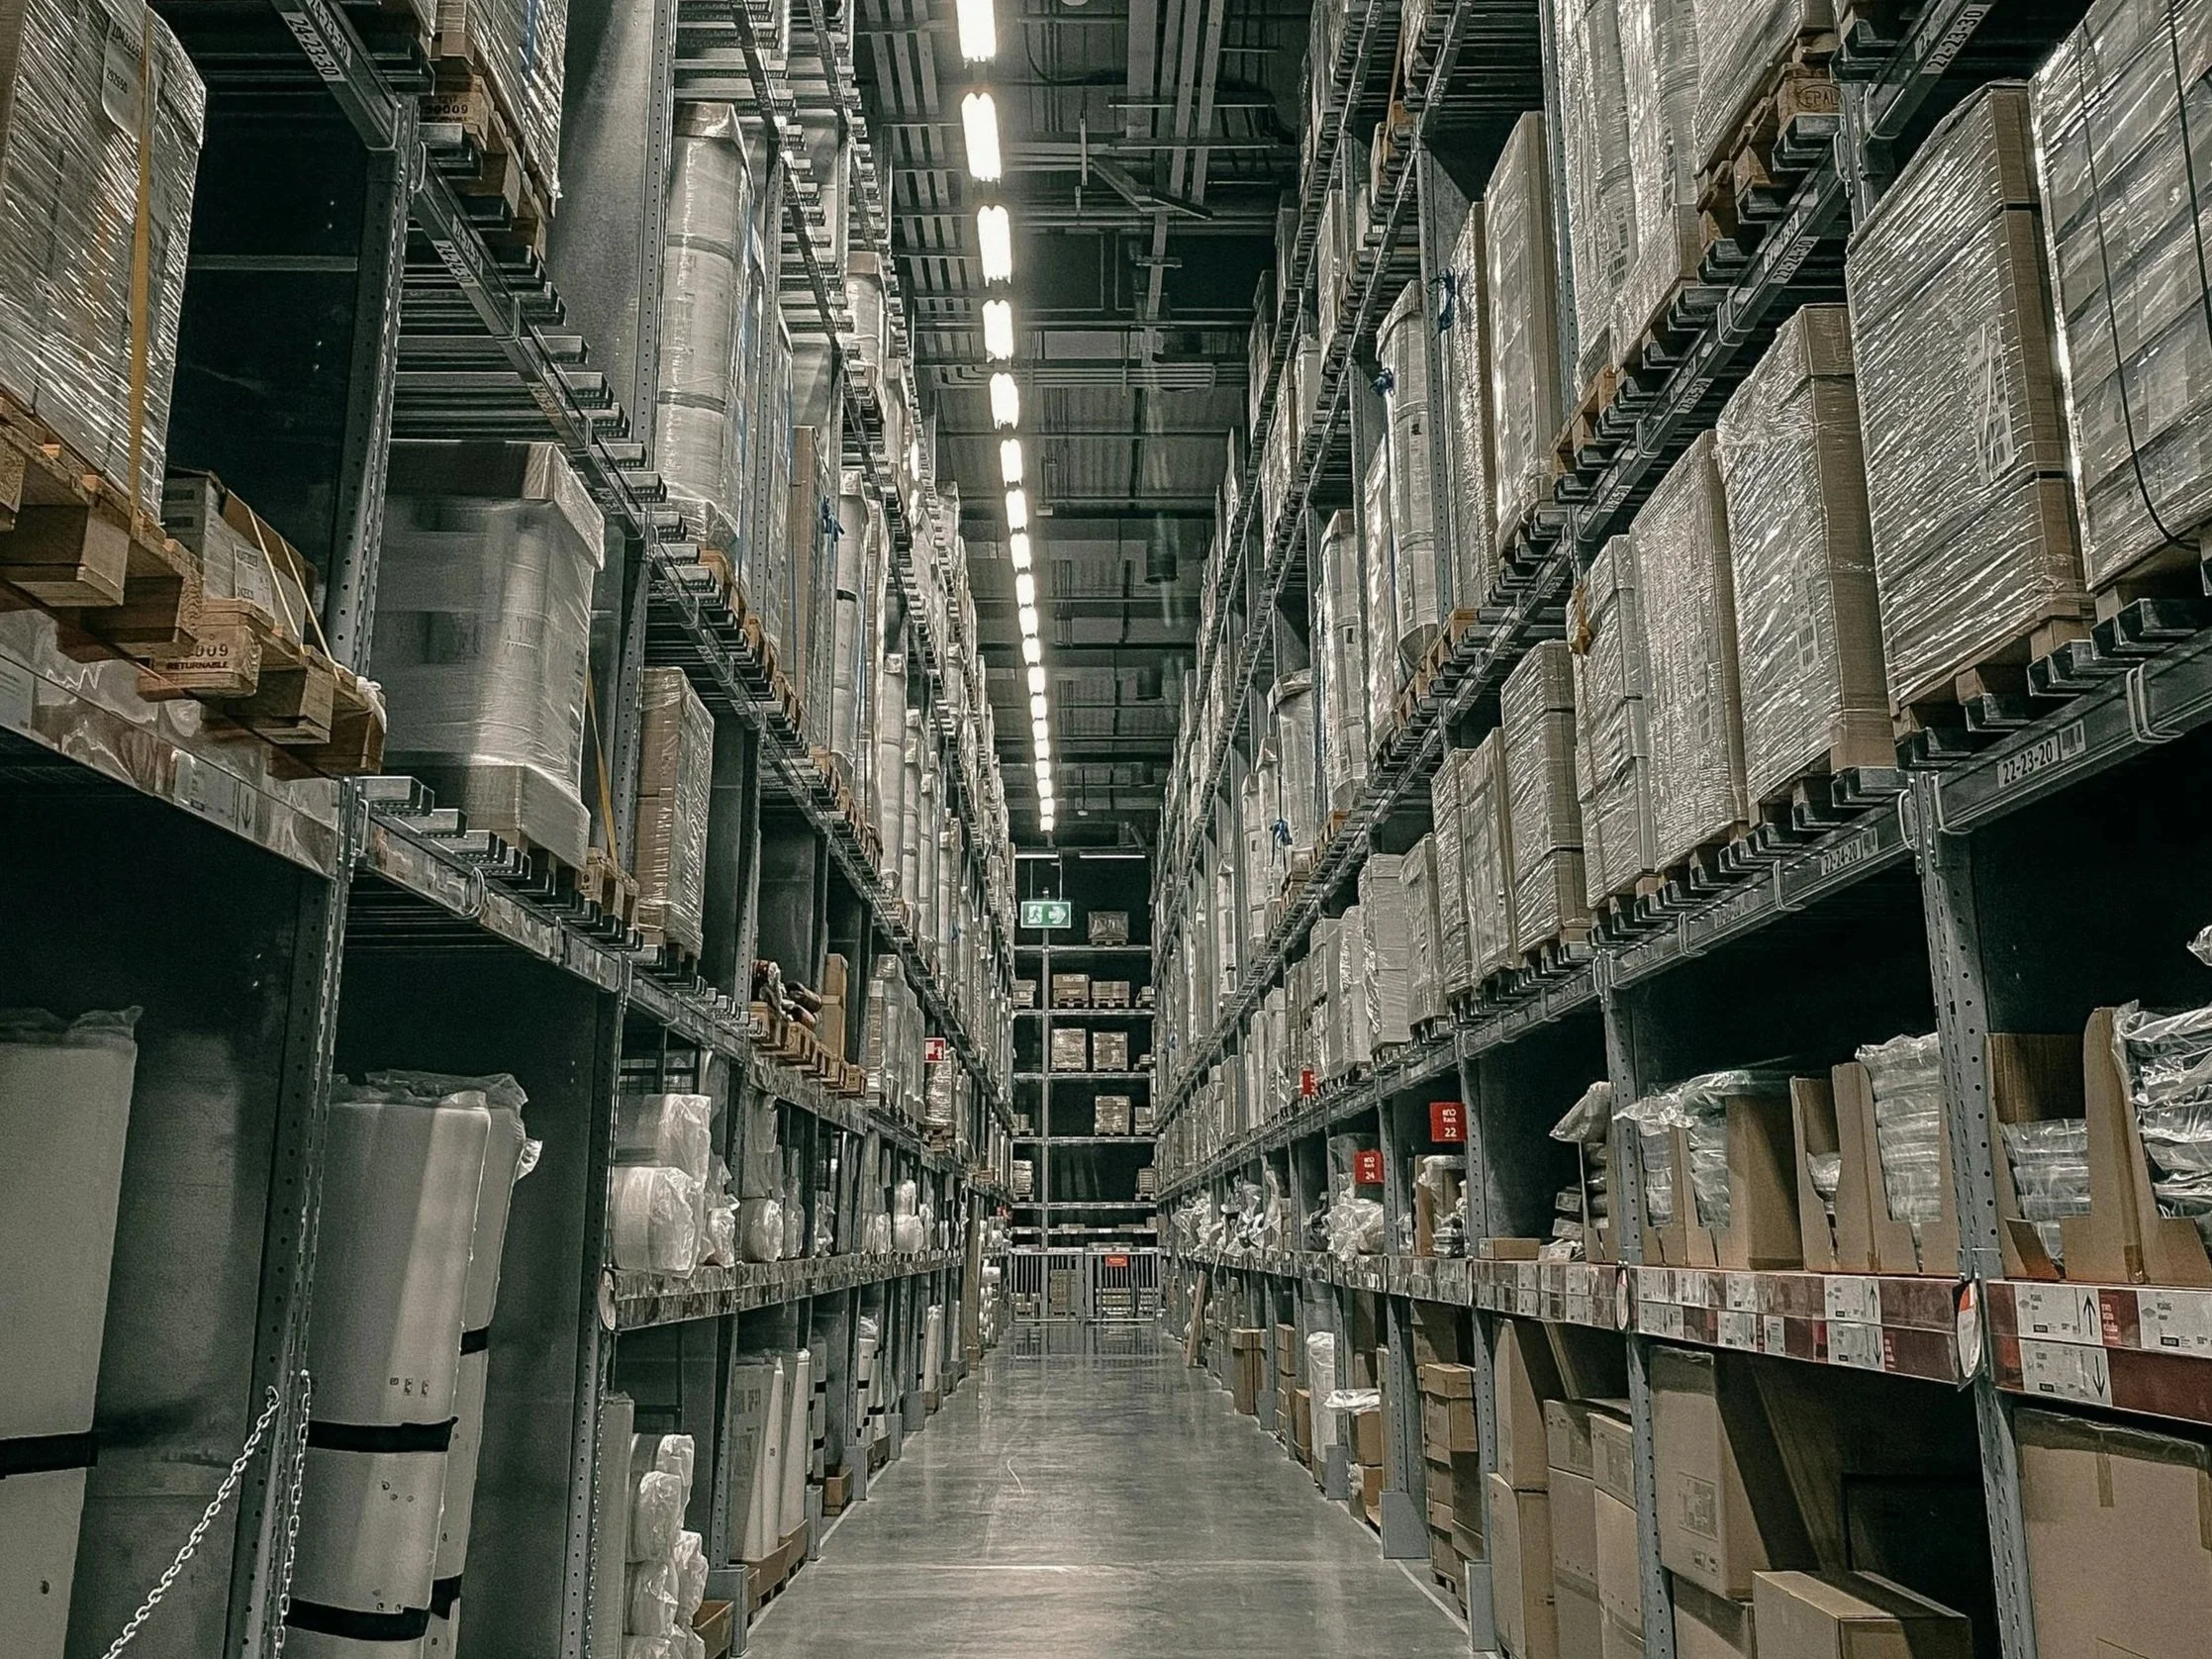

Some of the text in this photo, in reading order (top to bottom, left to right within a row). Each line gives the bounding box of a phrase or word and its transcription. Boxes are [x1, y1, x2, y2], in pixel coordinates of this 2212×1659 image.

[286, 18, 340, 75] 24-23-30
[1926, 10, 1983, 67] 22-23-30
[435, 244, 475, 283] 24-24-30
[1773, 241, 1816, 279] 22-24-30
[166, 661, 229, 670] RETURNABLE
[2002, 740, 2053, 785] 22-23-20
[1824, 841, 1858, 873] 22-24-20
[1445, 1127, 1457, 1137] 22
